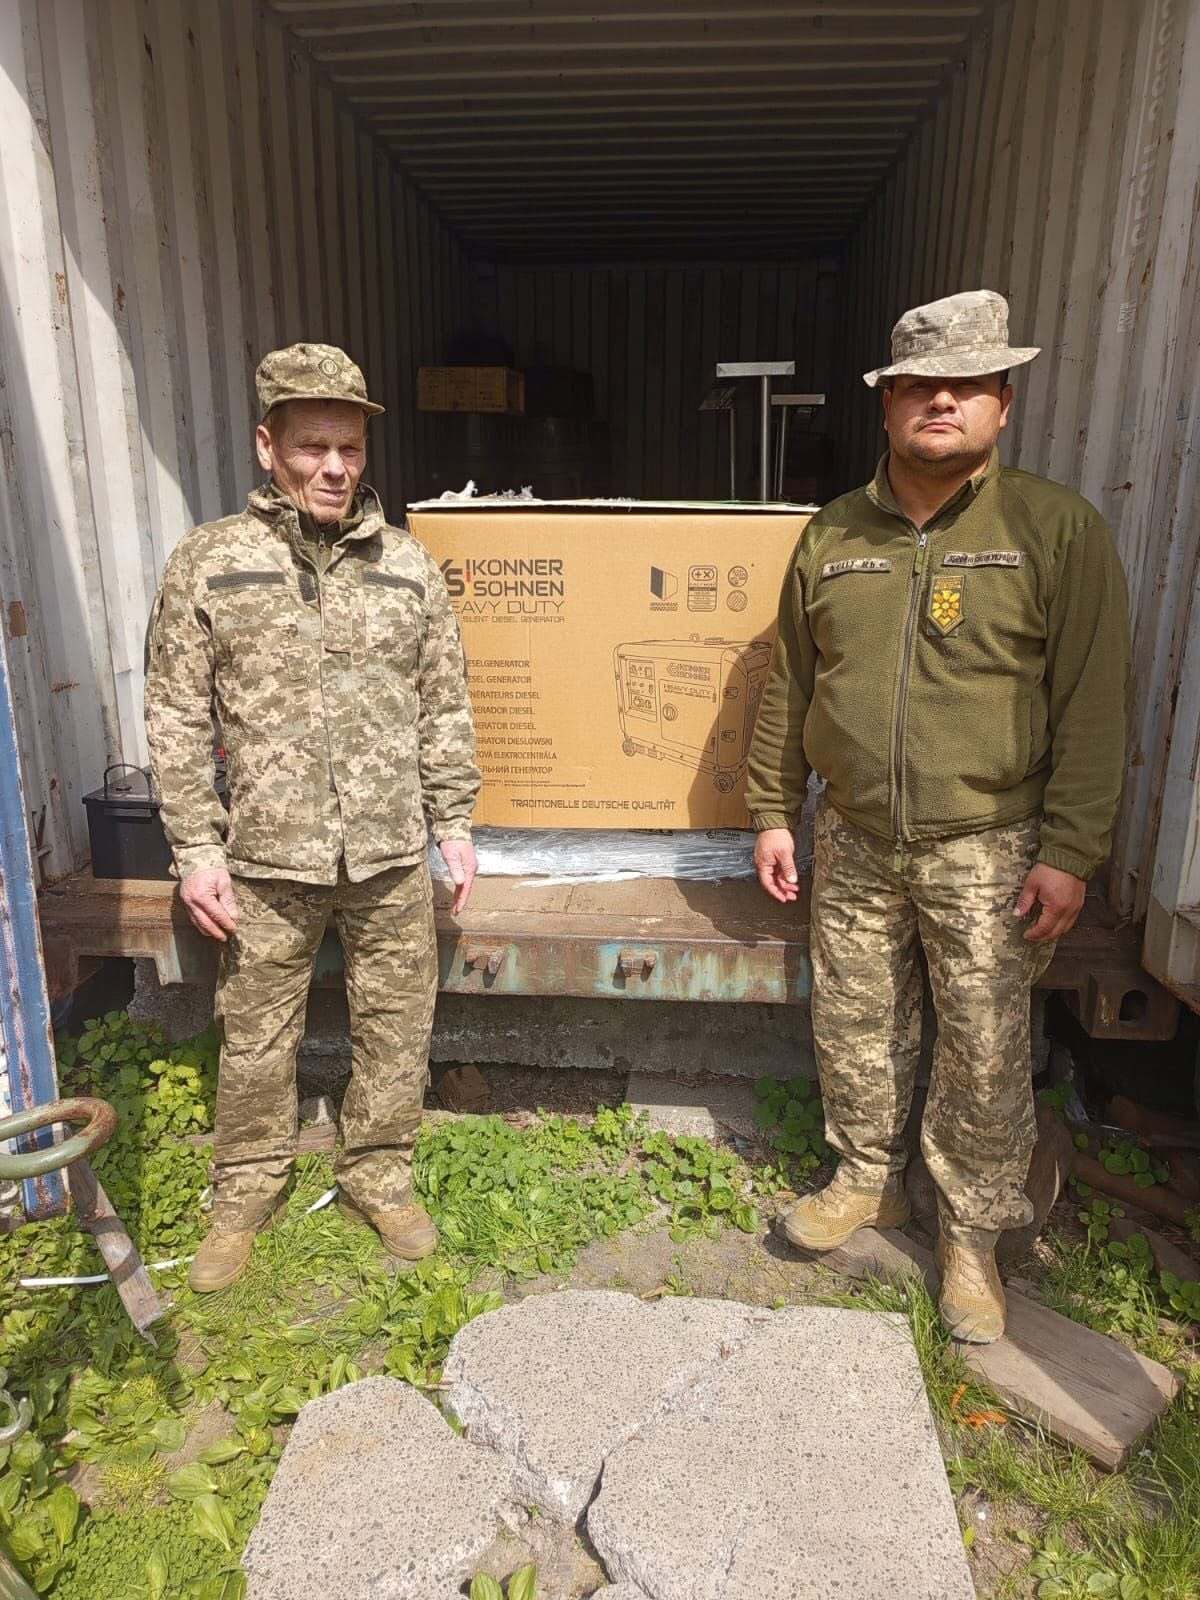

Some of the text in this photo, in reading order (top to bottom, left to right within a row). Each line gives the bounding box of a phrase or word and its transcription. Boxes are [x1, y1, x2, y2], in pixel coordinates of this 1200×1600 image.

[450, 600, 565, 614] EAVY DUTY
[462, 615, 565, 623] SILENT DIESEL GENERATOR
[467, 659, 530, 668] ESELGENERATOR
[468, 675, 532, 684] ESEL GENERATOR
[515, 691, 541, 700] DIESEL
[472, 705, 536, 715] NERADOR DIESEL
[509, 722, 536, 730] DIESEL
[477, 737, 553, 746] ERATOR DIESLOWSKI
[511, 766, 553, 775] ГЕНЕРАТОР
[511, 799, 580, 809] TRADITIONELLE
[582, 800, 630, 810] DEUTSCHE
